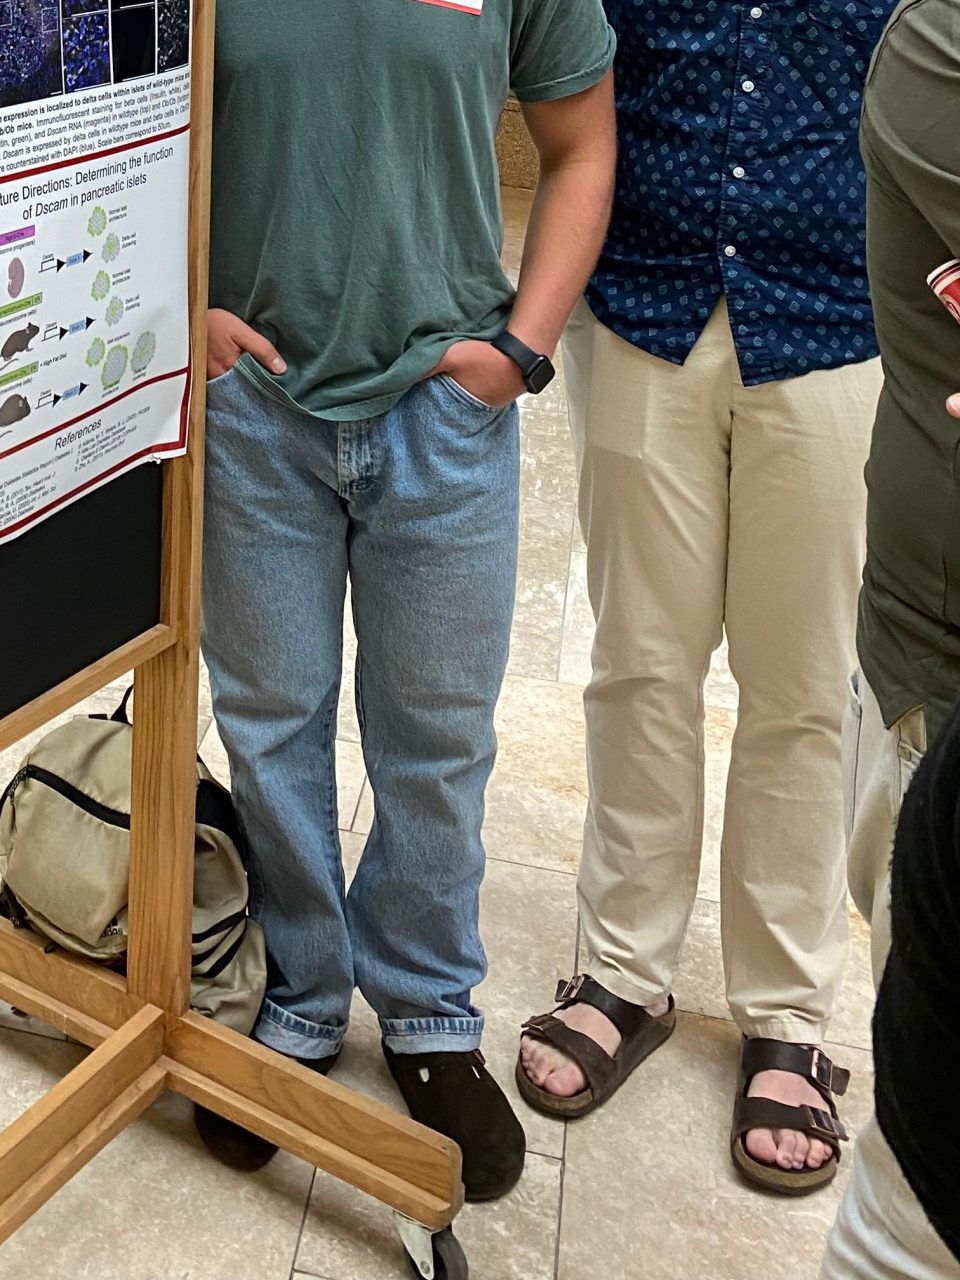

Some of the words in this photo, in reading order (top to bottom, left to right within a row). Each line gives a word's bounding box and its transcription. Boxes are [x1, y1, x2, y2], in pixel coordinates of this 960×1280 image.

[22, 177, 72, 200] Directions:
[76, 161, 127, 185] Determining
[129, 156, 142, 169] the
[144, 147, 173, 164] function
[23, 204, 33, 220] of
[35, 198, 68, 217] Dscam
[70, 193, 78, 207] in
[81, 181, 125, 206] pancreatic
[126, 173, 147, 188] islets
[55, 418, 101, 450] References
